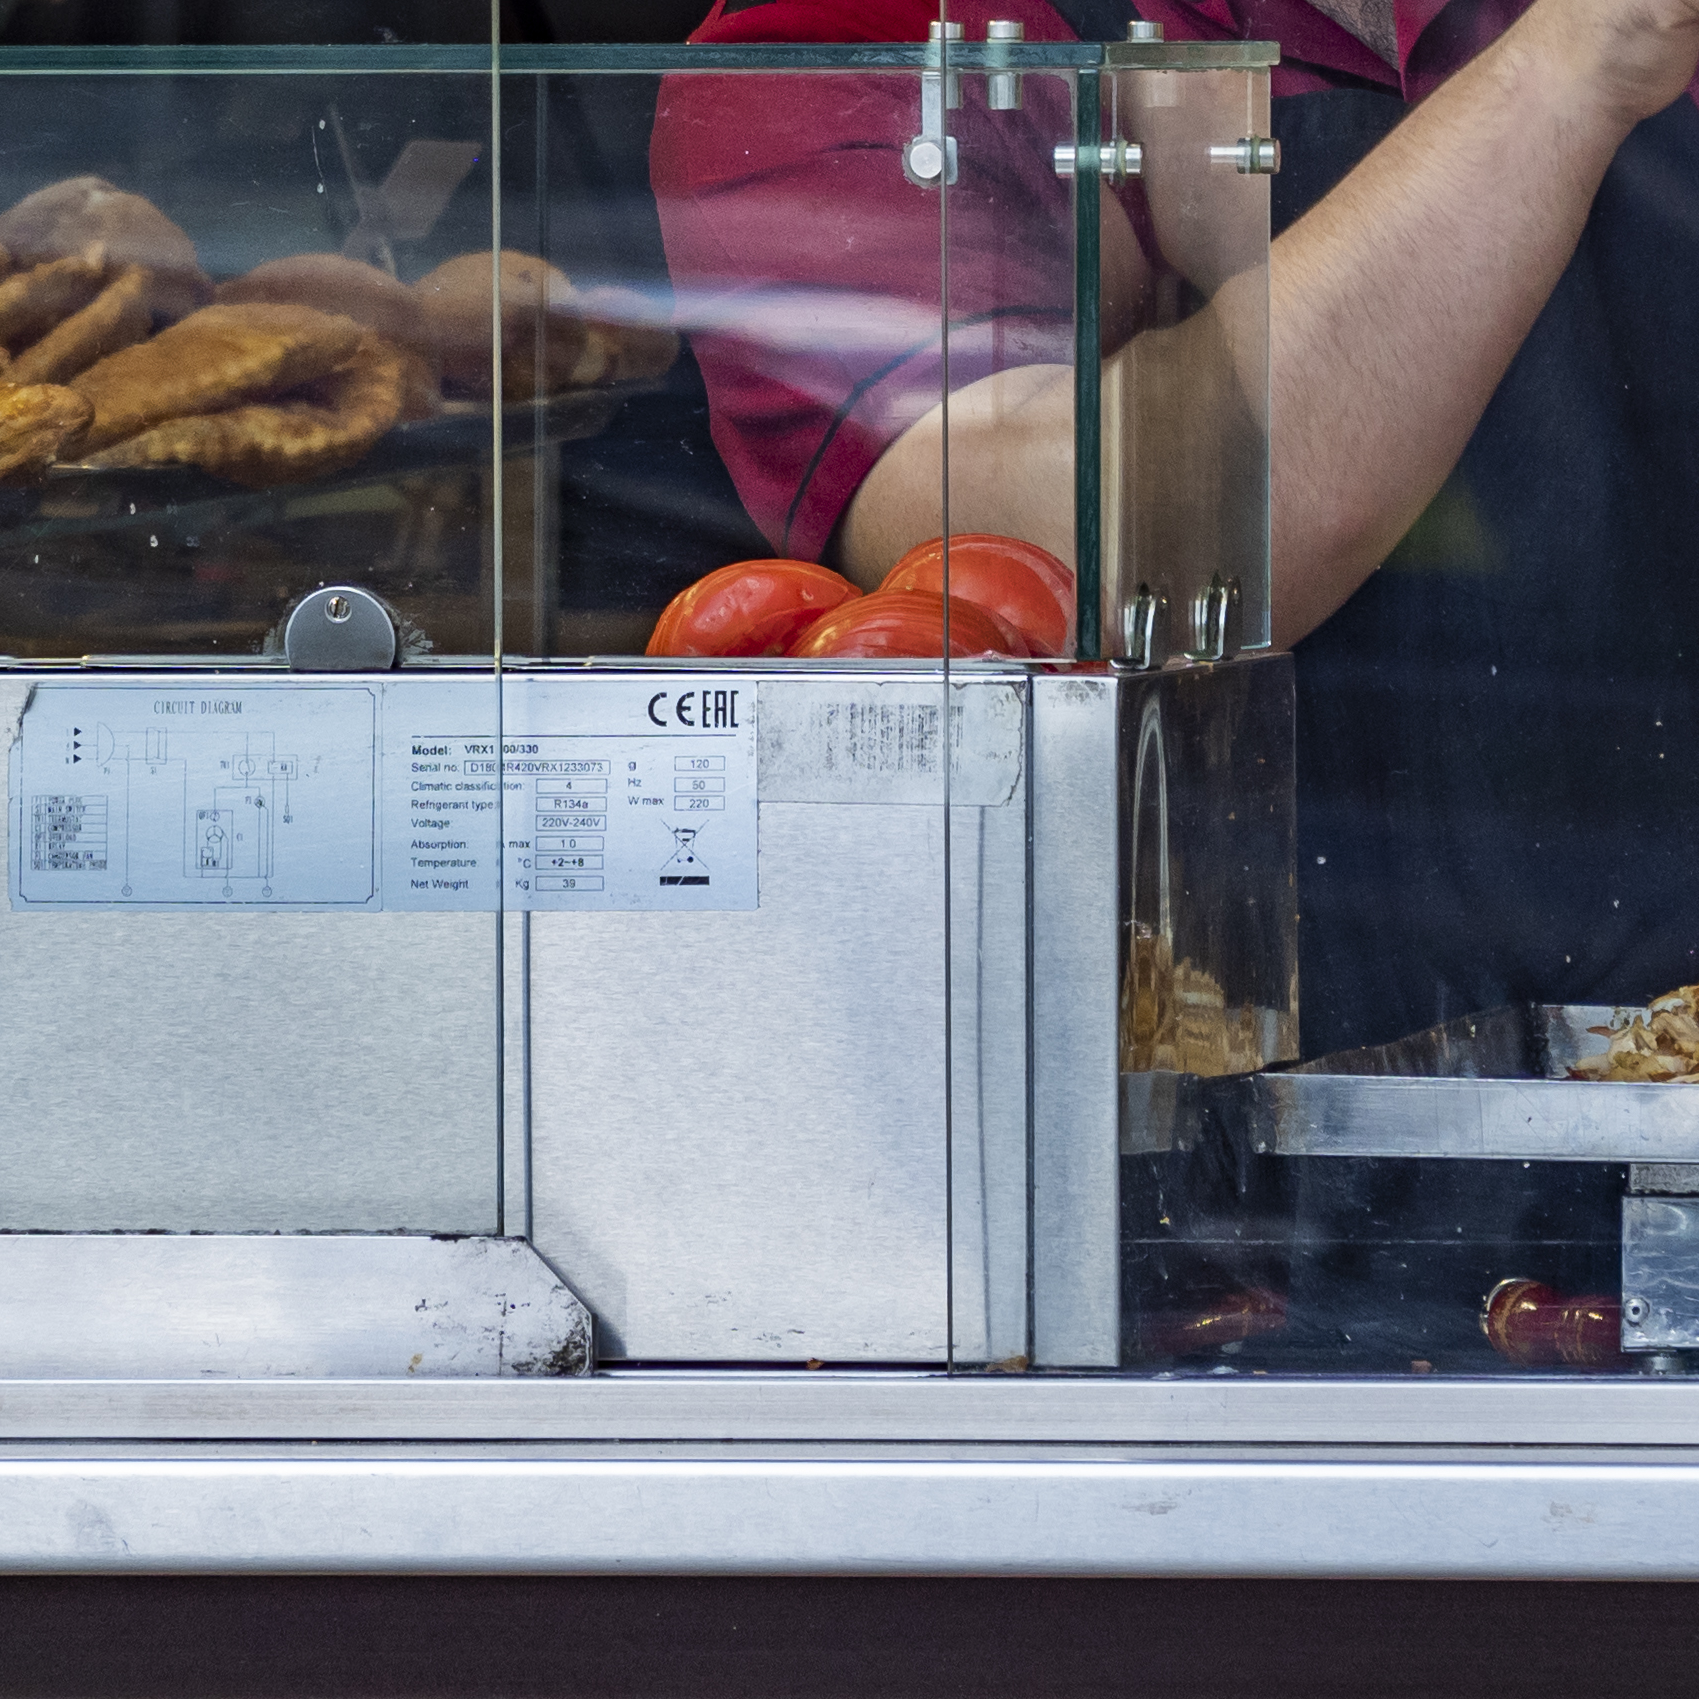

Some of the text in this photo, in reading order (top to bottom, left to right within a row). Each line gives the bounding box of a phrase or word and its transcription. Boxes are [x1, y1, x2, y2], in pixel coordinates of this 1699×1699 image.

[153, 700, 243, 714] CIRCUIT DIAGRAM
[647, 691, 696, 727] CE
[411, 744, 539, 756] Model: VRX100/330
[411, 762, 441, 773] Serial
[690, 758, 710, 769] 120
[411, 777, 706, 792] Climatic classifiction: 4 Hz 50
[411, 799, 469, 812] Refrigerant
[554, 799, 589, 810] R134a
[627, 795, 641, 806] W
[643, 798, 664, 807] max
[689, 798, 710, 809] 220
[541, 817, 601, 828] 220V-240V
[508, 840, 531, 849] max
[411, 879, 429, 890] Net
[515, 879, 530, 891] Kg
[562, 878, 576, 889] 39
